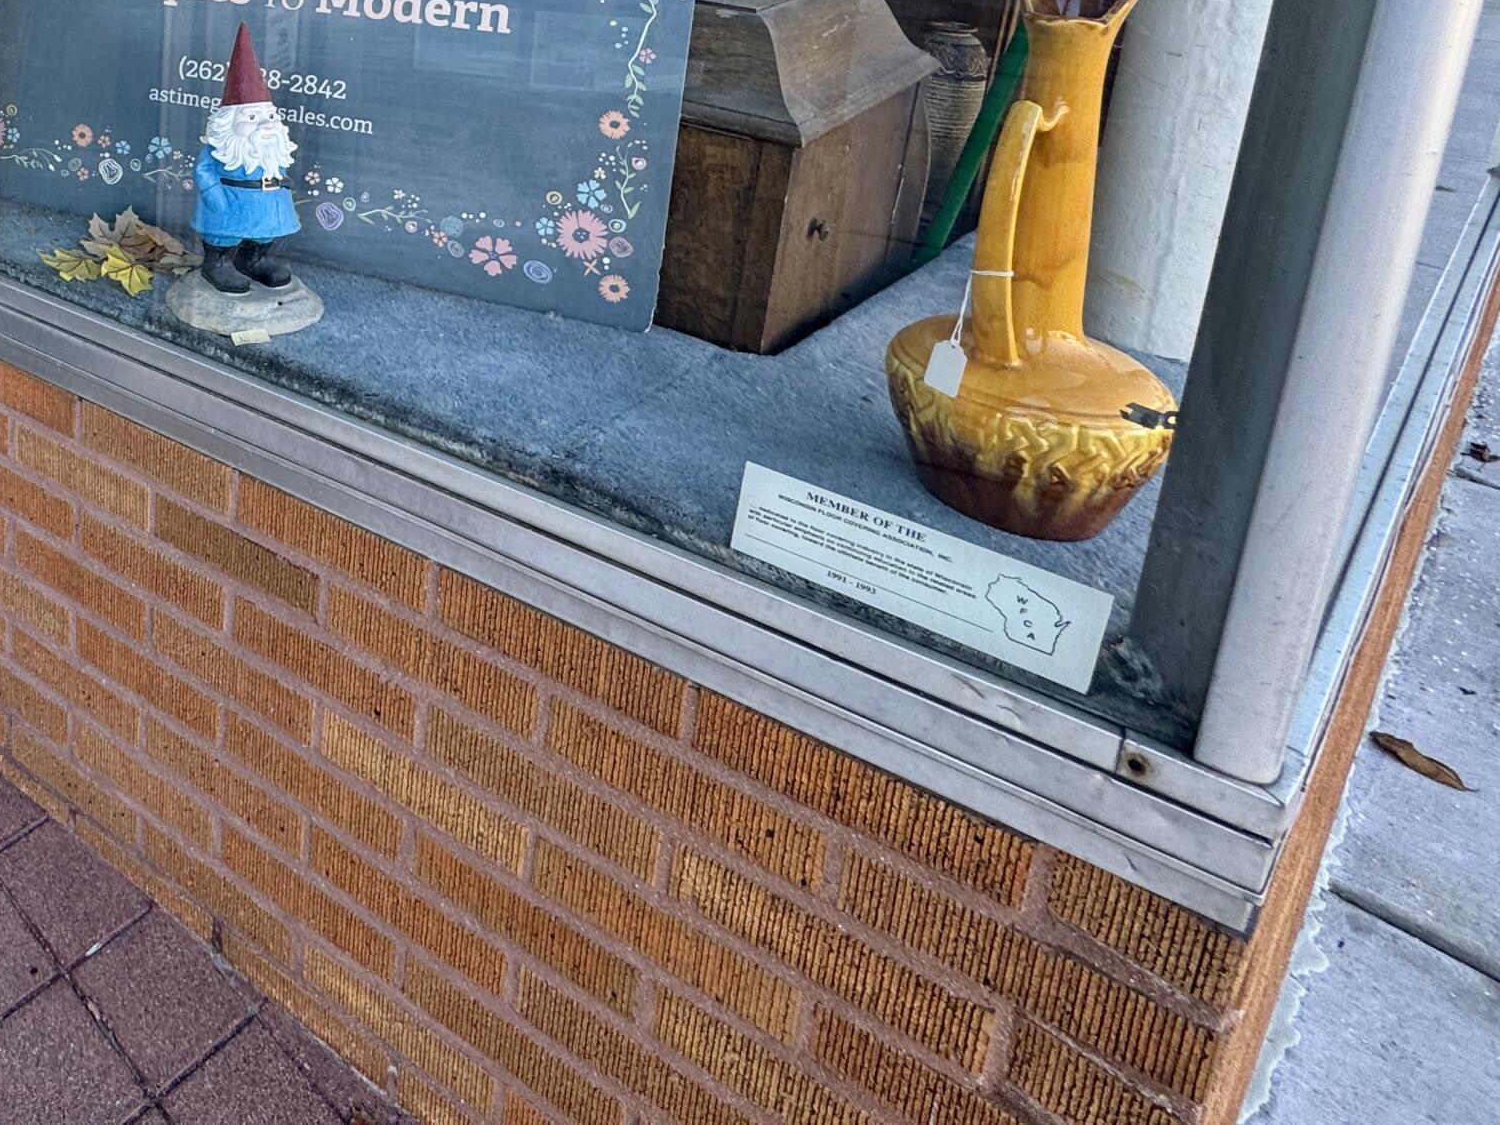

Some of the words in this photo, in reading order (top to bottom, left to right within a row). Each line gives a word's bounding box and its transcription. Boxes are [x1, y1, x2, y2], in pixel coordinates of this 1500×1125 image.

[778, 494, 817, 512] WISCONSIN
[817, 508, 842, 521] FLOOR
[843, 518, 880, 536] COVERING
[806, 491, 870, 522] MEMBER
[873, 516, 893, 530] OF
[896, 523, 927, 543] THE
[827, 570, 847, 584] 1991
[855, 582, 877, 595] 1993
